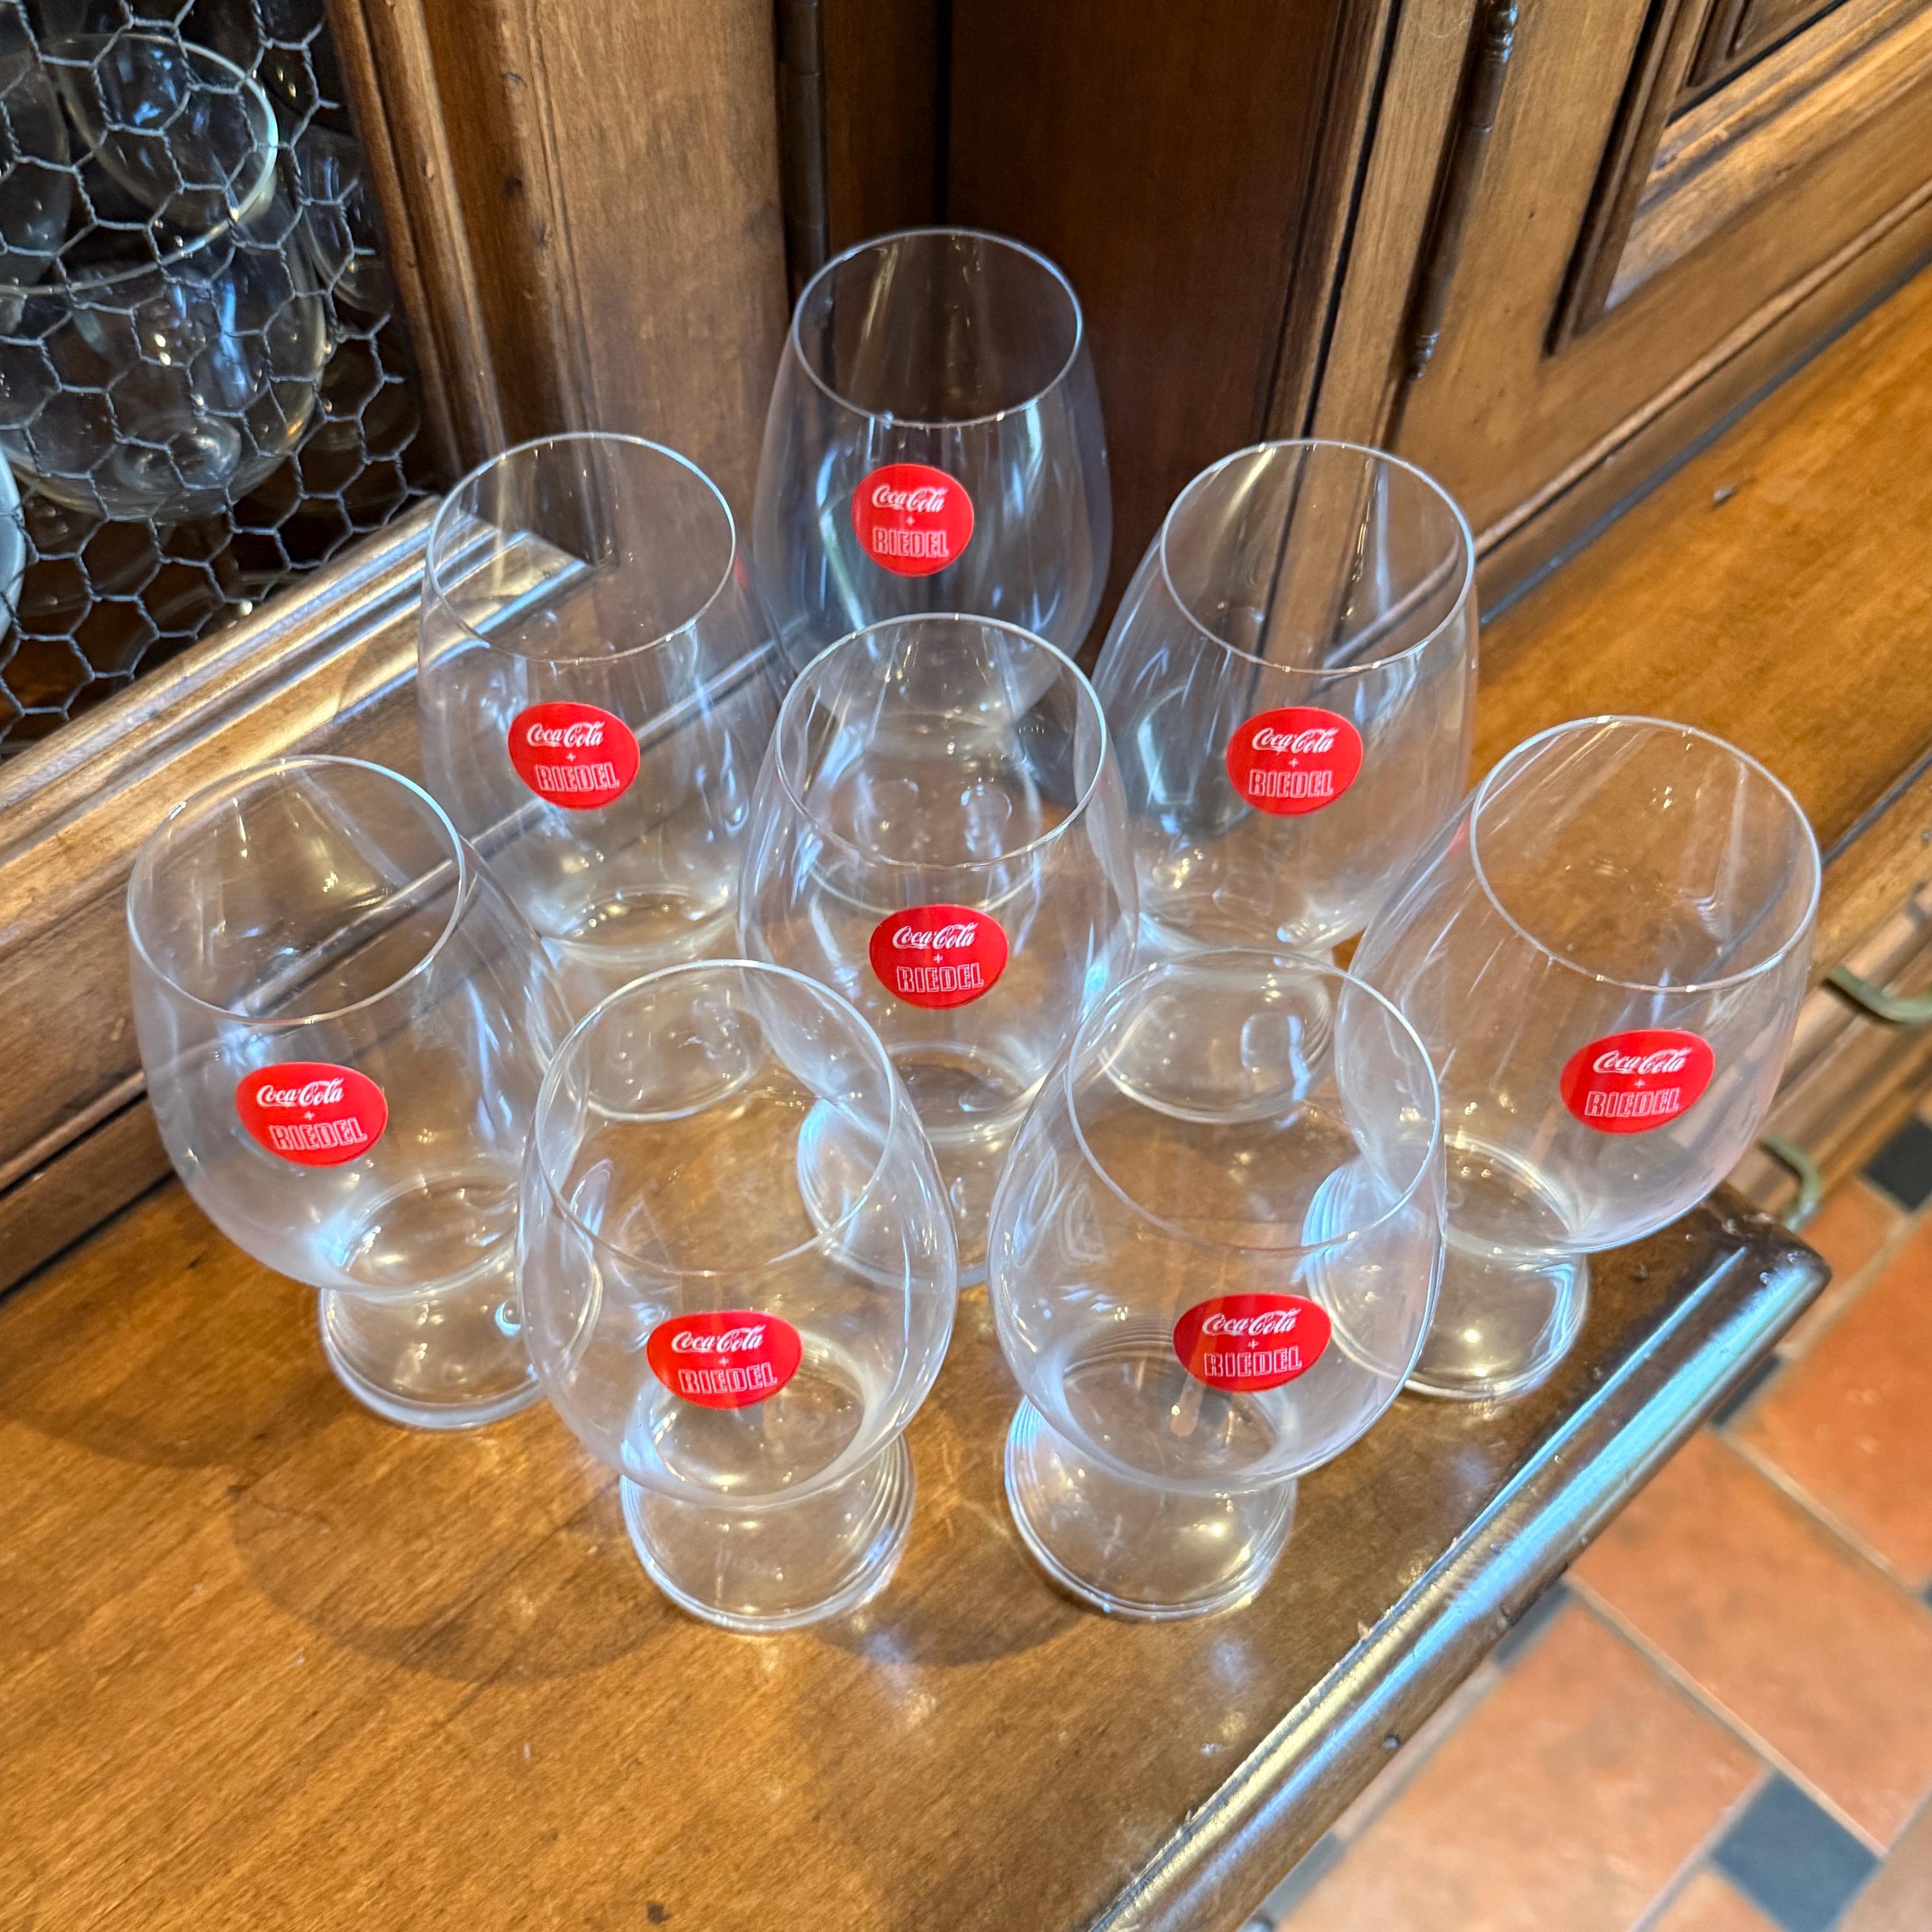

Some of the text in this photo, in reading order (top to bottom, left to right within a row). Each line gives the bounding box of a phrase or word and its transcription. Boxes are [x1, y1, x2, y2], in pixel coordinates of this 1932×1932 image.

[873, 526, 950, 558] RIEDEL
[535, 762, 620, 791] RIEDEL
[1249, 769, 1334, 798] RIEDEL
[896, 961, 984, 992] RIEDEL
[1585, 1087, 1681, 1117] RIEDEL
[268, 1116, 368, 1151] RIEDEL
[1204, 1346, 1303, 1378] RIEDEL
[678, 1362, 778, 1394] RIEDEL
